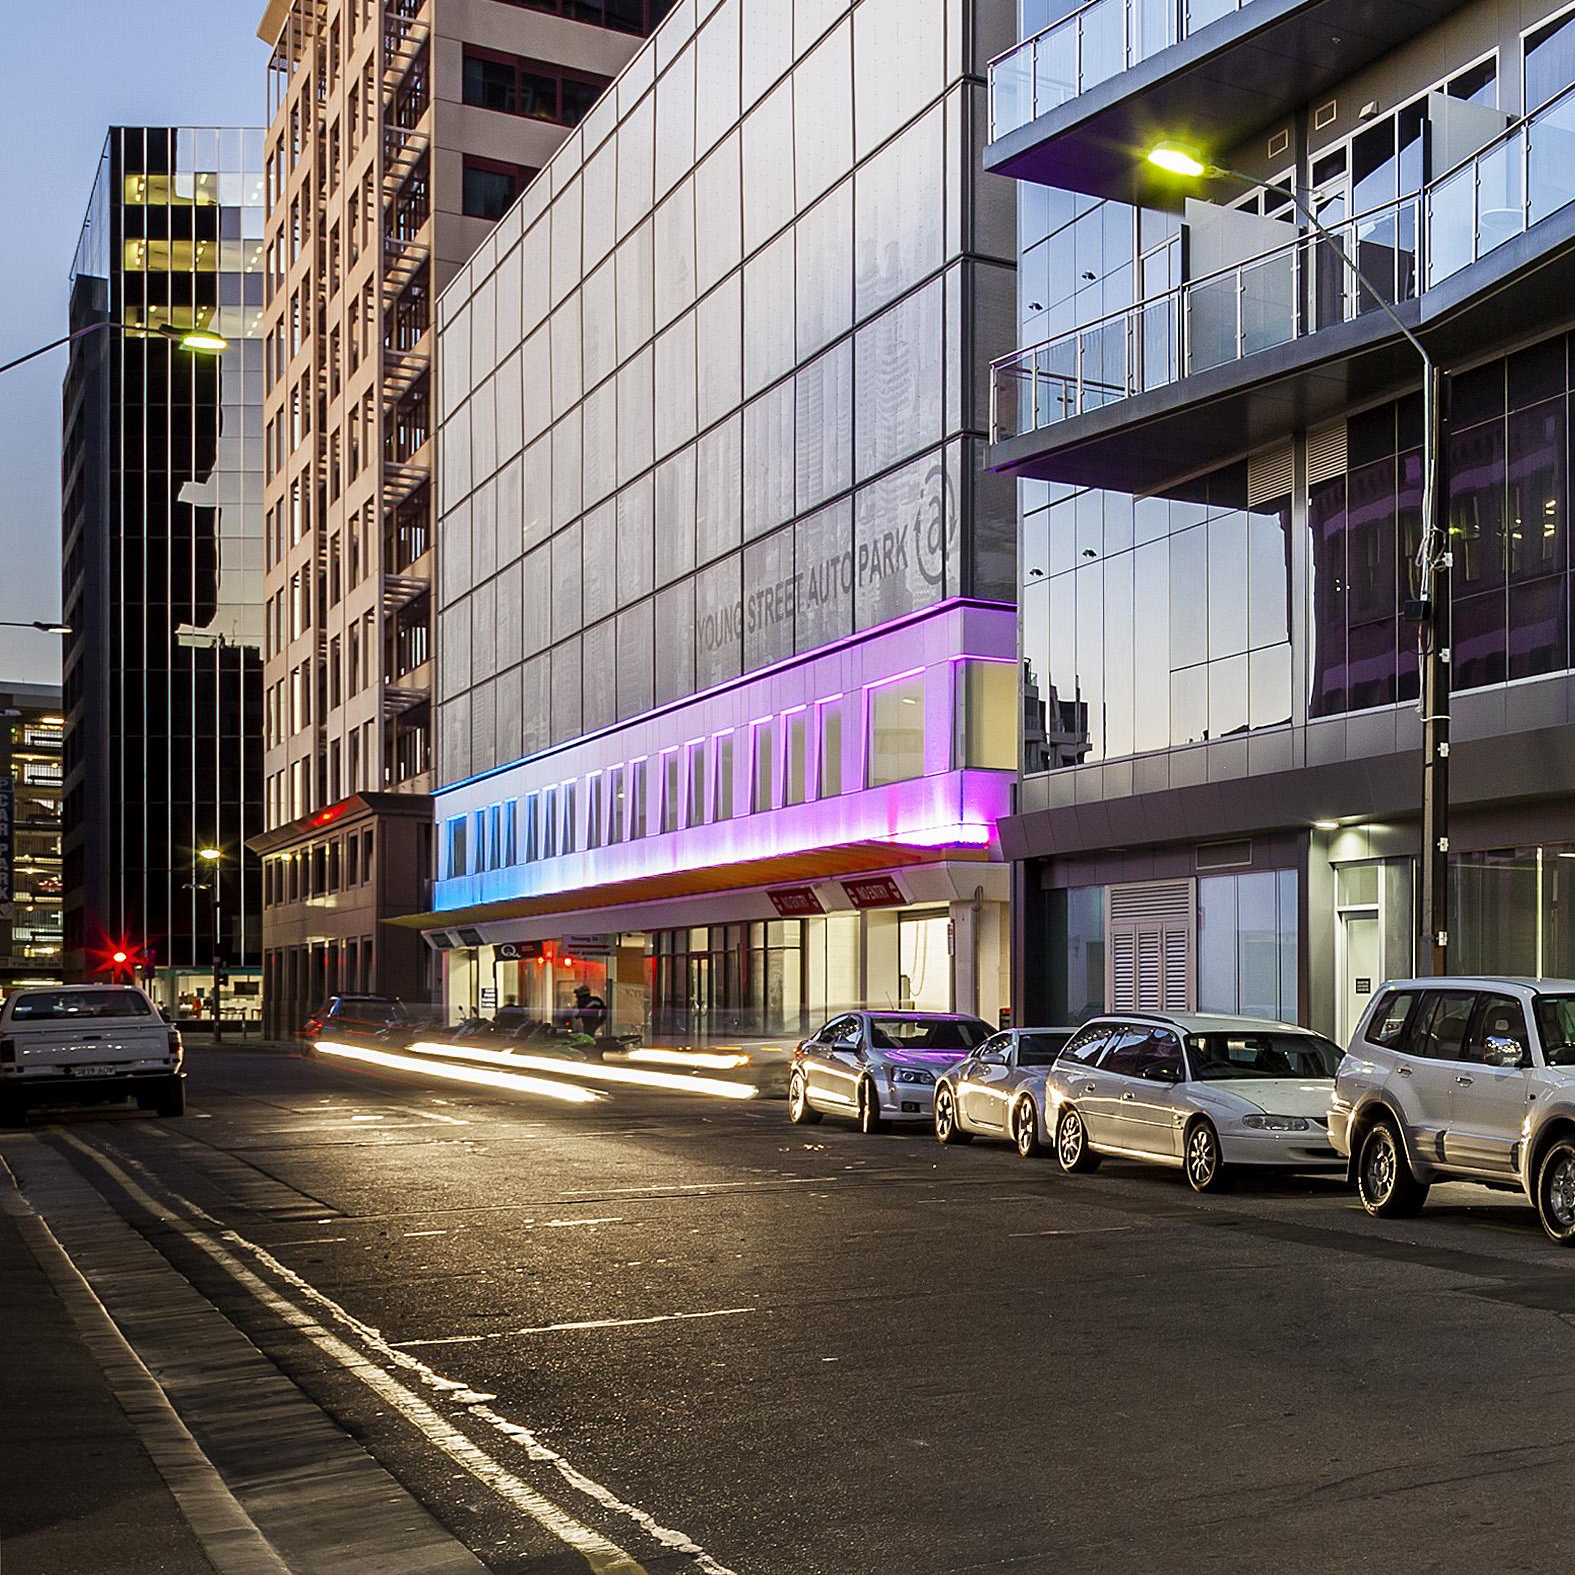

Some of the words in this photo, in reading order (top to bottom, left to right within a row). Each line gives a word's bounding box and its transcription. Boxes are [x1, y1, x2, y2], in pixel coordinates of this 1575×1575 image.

[698, 601, 743, 654] YOUNG
[750, 572, 803, 633] STREET
[807, 551, 853, 608] AUTO
[859, 524, 908, 587] PARK
